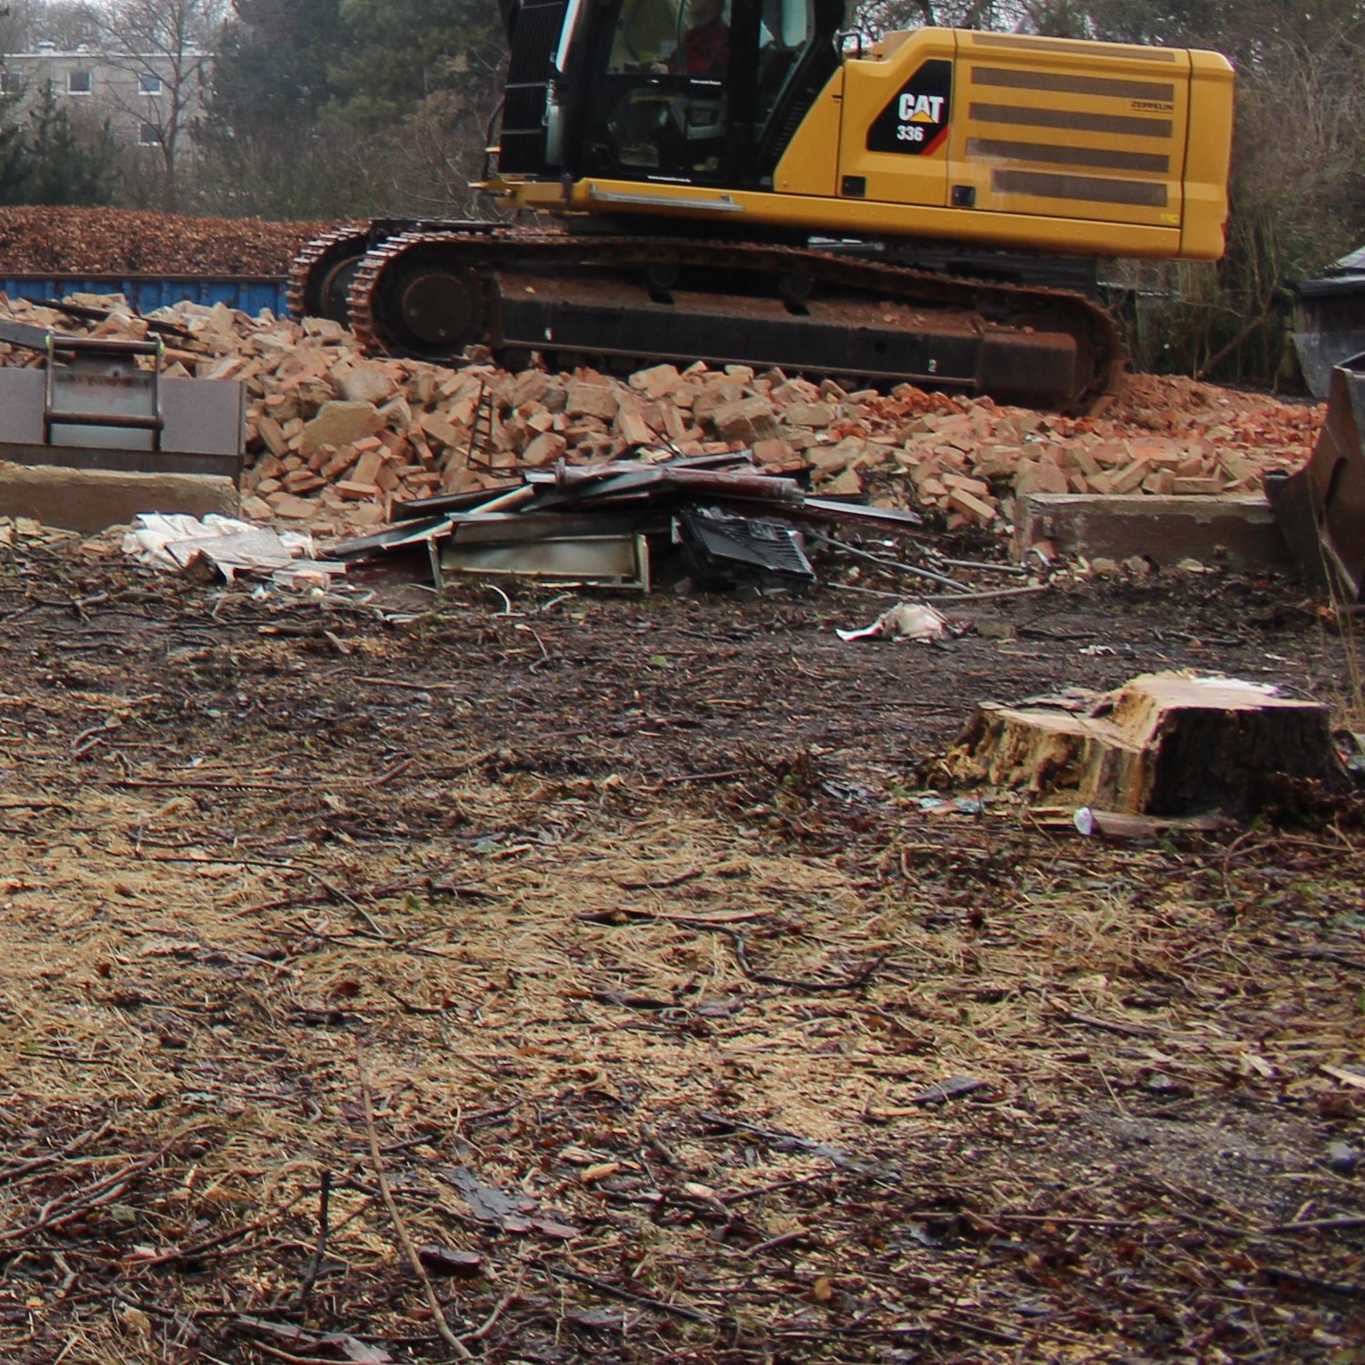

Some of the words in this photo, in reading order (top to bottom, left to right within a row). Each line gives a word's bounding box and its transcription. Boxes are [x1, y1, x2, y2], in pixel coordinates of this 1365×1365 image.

[898, 93, 944, 124] CAT
[1130, 101, 1174, 111] ZEPPELIN
[896, 125, 924, 142] 336
